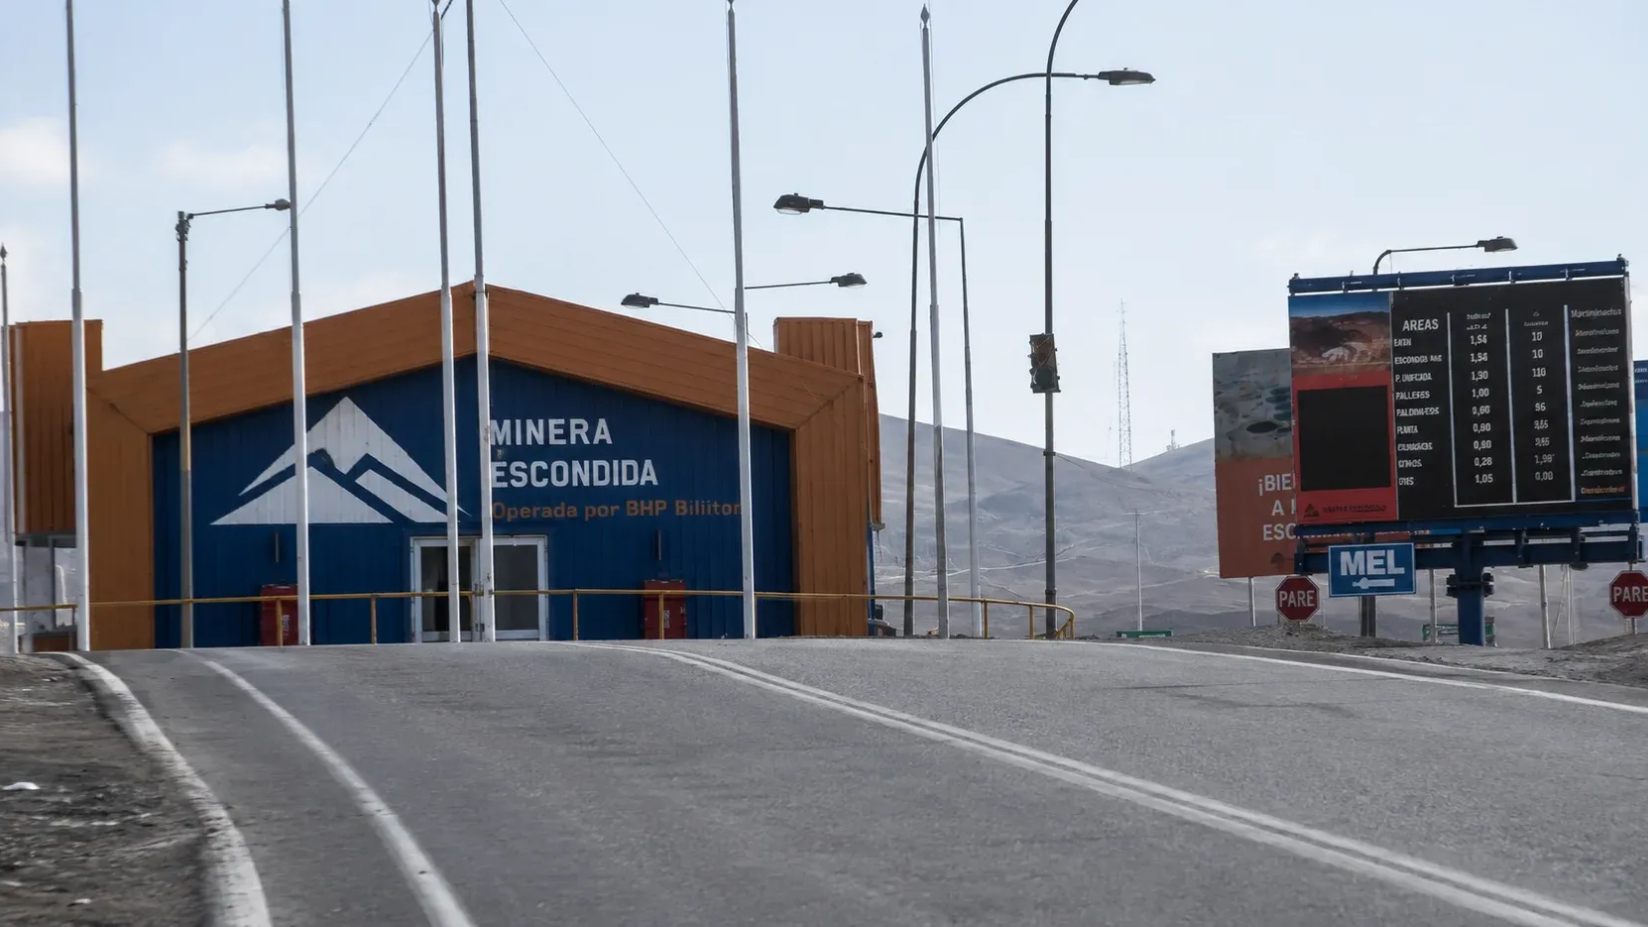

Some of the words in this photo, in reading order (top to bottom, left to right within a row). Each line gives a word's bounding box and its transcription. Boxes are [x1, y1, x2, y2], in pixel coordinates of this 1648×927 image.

[1402, 319, 1439, 331] AREAS
[1532, 349, 1544, 359] 10
[490, 418, 613, 446] MINERA
[491, 459, 659, 488] ESCONDIDA
[1258, 473, 1296, 496] ¡BIE
[492, 501, 578, 521] Operada
[584, 503, 620, 521] por
[626, 499, 667, 517] BHP
[1271, 500, 1285, 516] A
[1340, 550, 1405, 576] MEL
[1279, 590, 1315, 608] PARE
[1613, 586, 1648, 602] PARE
